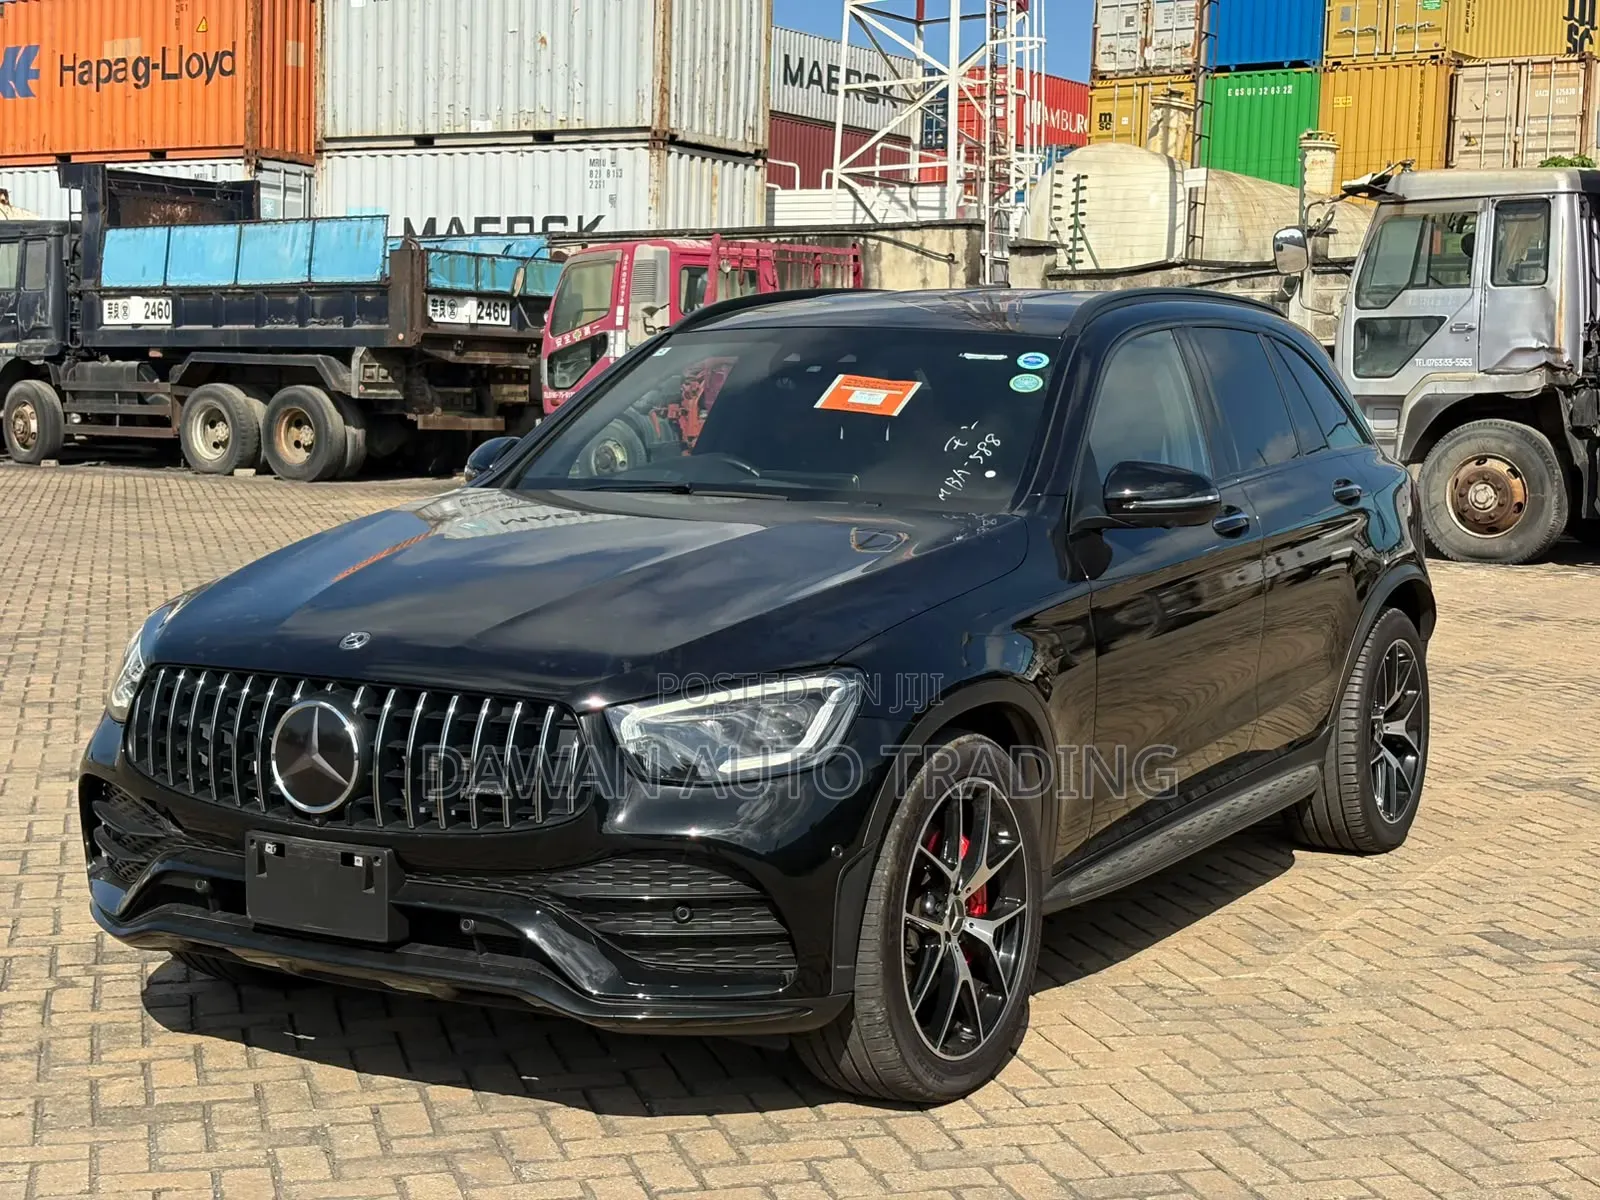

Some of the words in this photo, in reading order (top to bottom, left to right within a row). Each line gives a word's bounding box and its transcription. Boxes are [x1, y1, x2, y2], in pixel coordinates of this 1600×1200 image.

[60, 41, 237, 90] Hapag-Lloyd
[783, 54, 898, 109] MAERSK
[144, 301, 171, 320] 2460
[477, 301, 507, 322] 2460
